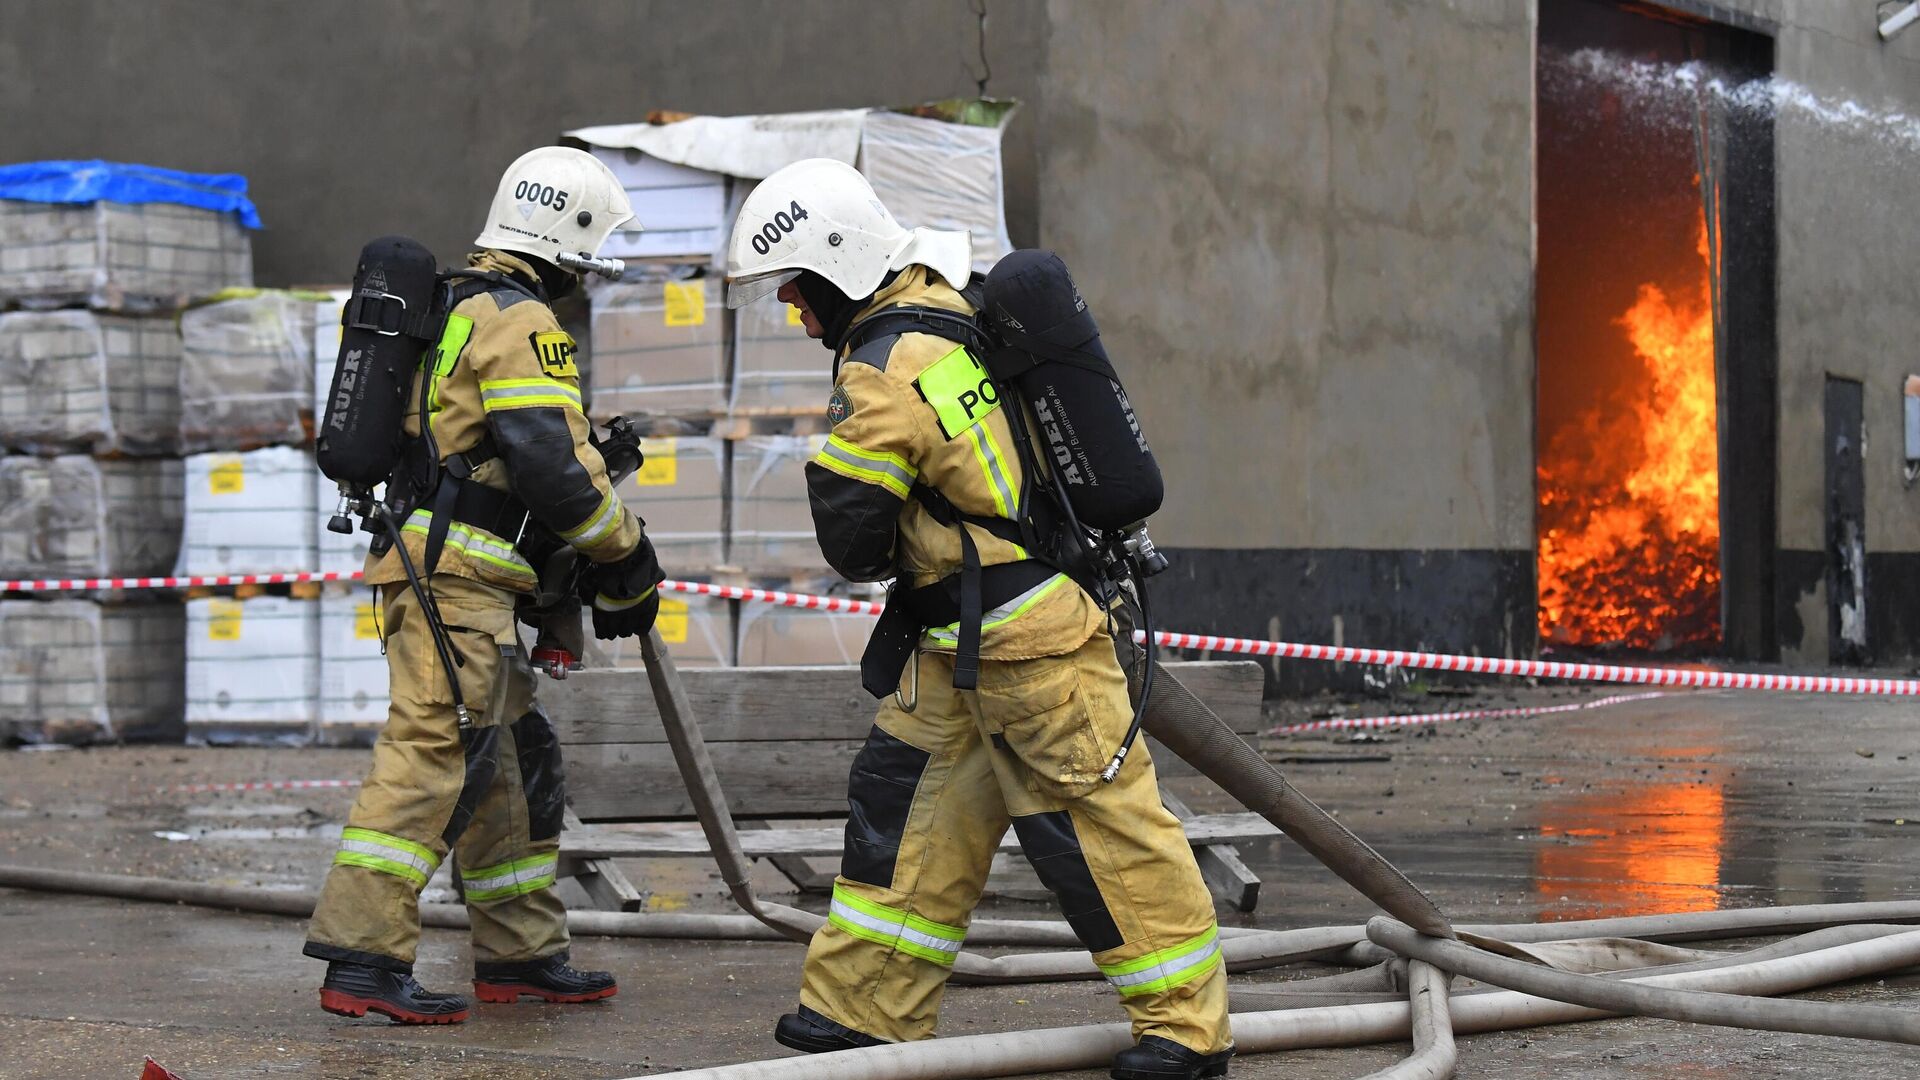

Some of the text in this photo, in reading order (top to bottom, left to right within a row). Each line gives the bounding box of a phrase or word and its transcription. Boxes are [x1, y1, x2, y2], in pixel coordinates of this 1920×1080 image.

[515, 180, 569, 212] 0005
[752, 200, 808, 255] 0004
[330, 349, 362, 431] AUER
[1046, 385, 1058, 397] Air
[1034, 397, 1084, 485] AUER
[1053, 398, 1080, 446] Breathable
[1076, 450, 1100, 486] Atemluft
